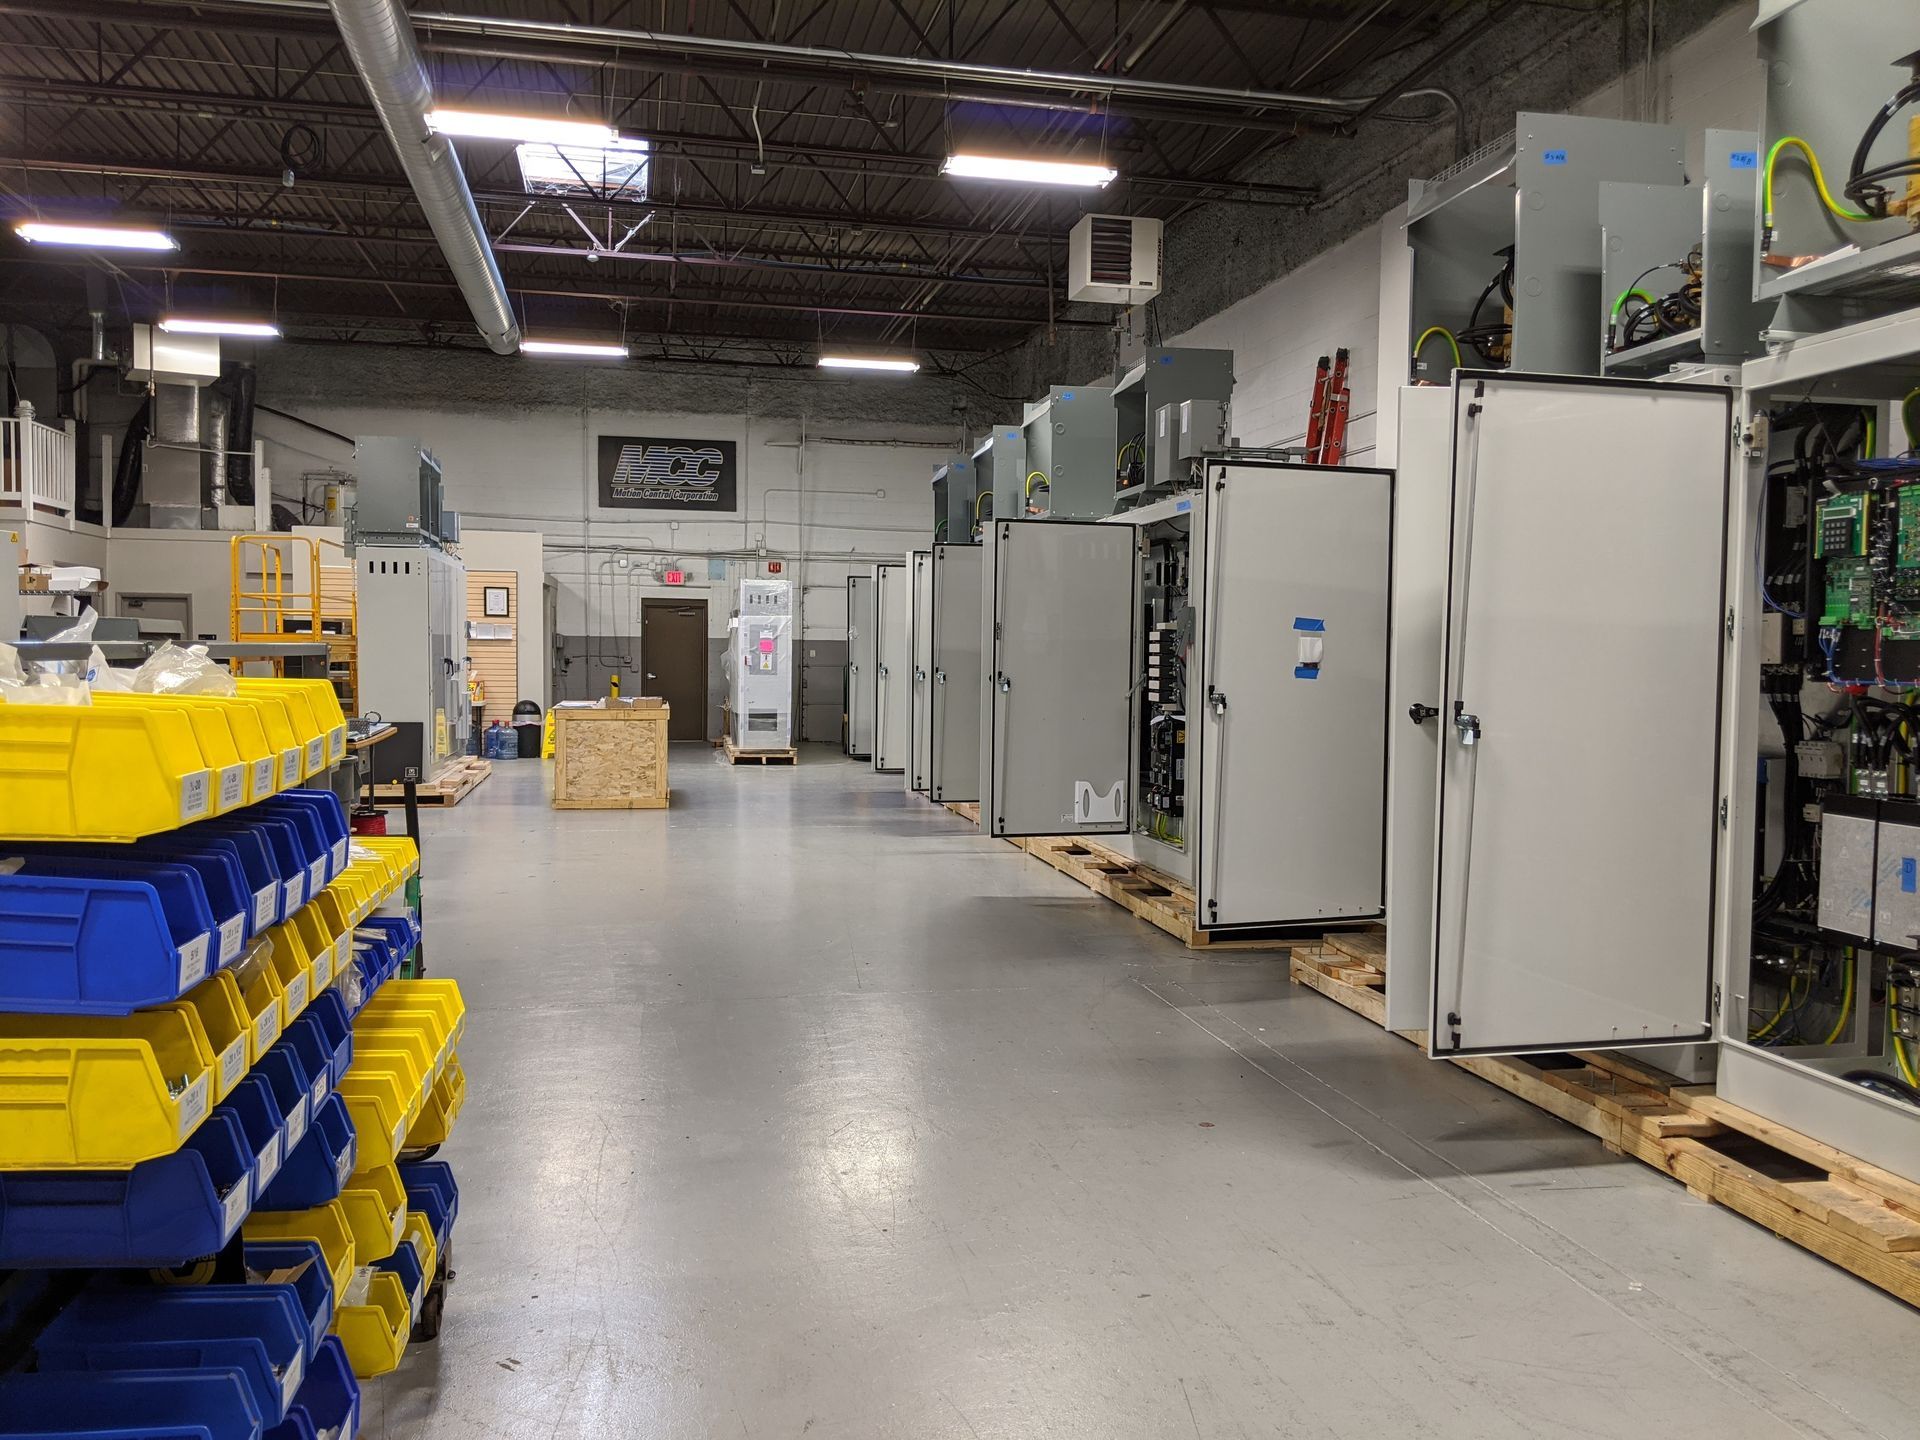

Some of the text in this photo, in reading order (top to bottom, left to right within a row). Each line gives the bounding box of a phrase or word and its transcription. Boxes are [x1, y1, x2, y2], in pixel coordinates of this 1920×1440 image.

[612, 445, 724, 487] MCC
[612, 487, 719, 502] Motion Control Corporation
[667, 571, 681, 583] EXIT
